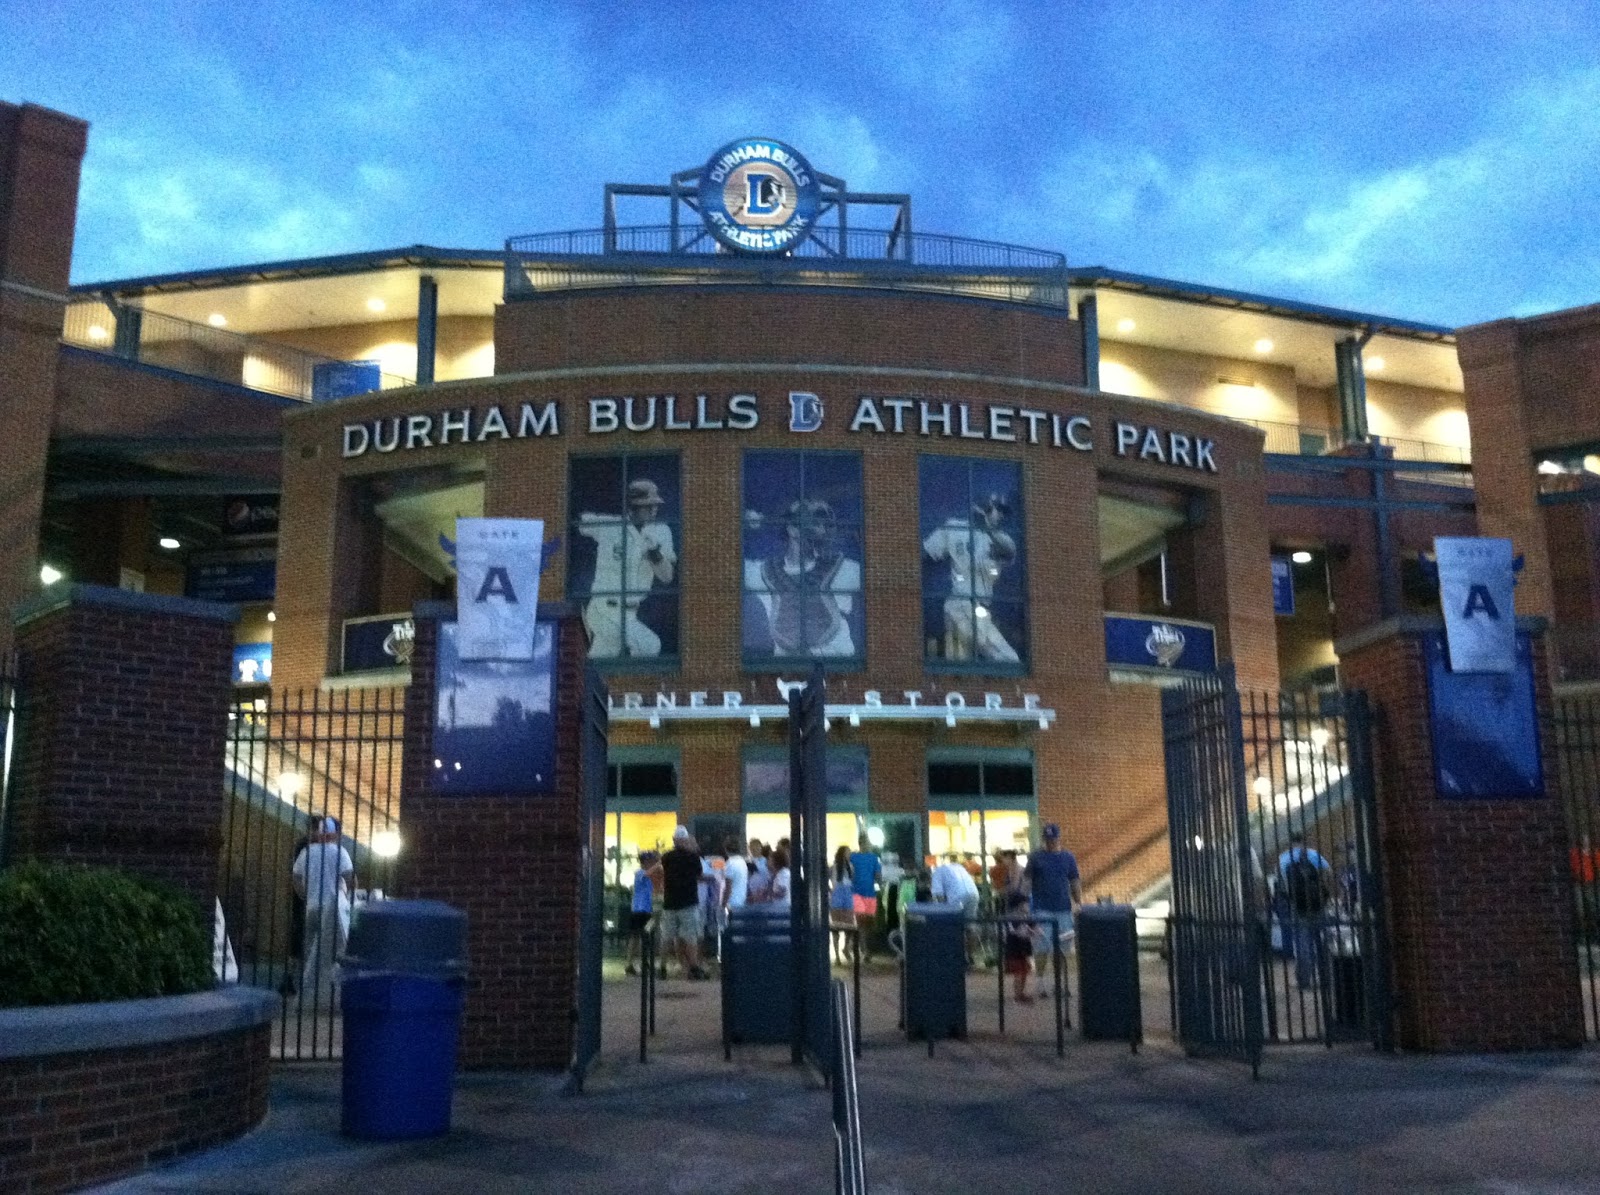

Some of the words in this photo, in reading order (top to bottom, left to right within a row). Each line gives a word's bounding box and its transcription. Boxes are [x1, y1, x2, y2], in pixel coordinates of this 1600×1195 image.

[710, 144, 770, 183] DURHAM
[771, 149, 811, 187] BULLS
[342, 400, 560, 458] DURHAM
[588, 394, 759, 433] BULLS
[850, 398, 1094, 452] ATHLETIC
[1116, 422, 1218, 473] PARK
[475, 566, 519, 604] A
[1463, 584, 1500, 621] A
[864, 689, 1042, 712] STORE
